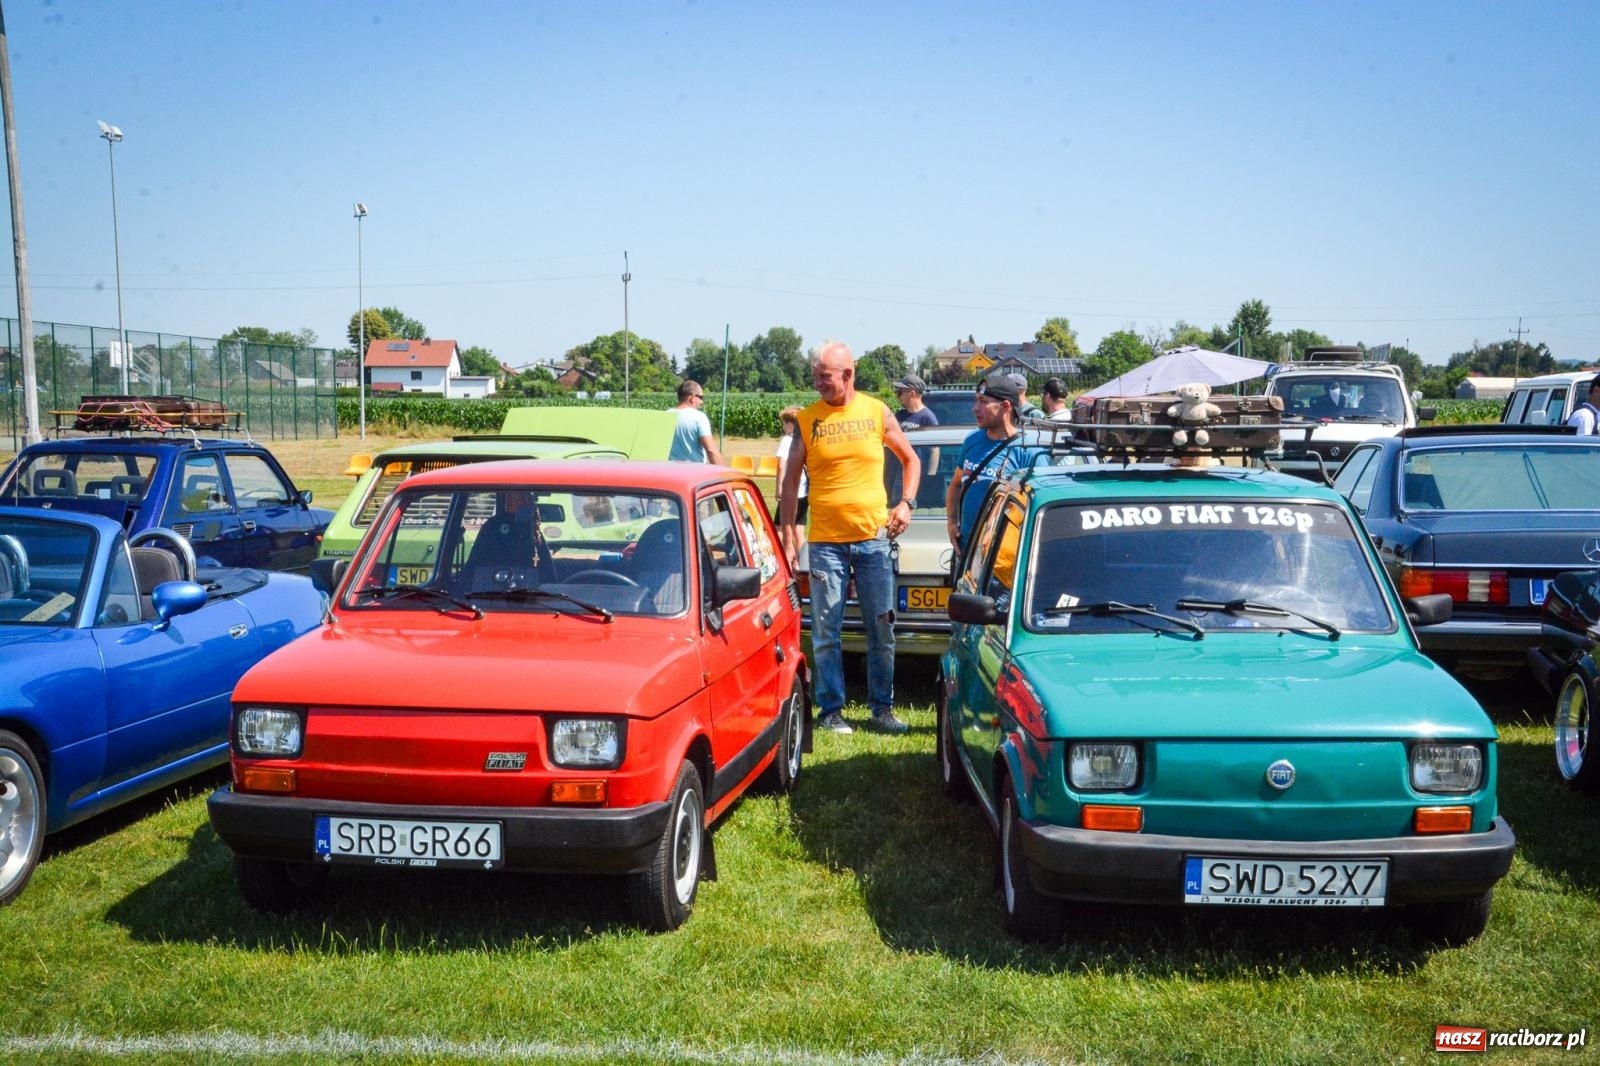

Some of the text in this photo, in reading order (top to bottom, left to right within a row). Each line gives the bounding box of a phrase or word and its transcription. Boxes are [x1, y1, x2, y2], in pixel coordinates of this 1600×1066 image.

[819, 419, 876, 438] BOXEUR
[1080, 506, 1162, 530] DARO
[1168, 506, 1235, 525] FIAT
[1242, 506, 1314, 534] 126p
[911, 589, 945, 607] SGL
[488, 760, 524, 768] FIAT
[1272, 770, 1292, 780] FIAT
[318, 822, 492, 858] PL SRB GR66
[375, 858, 438, 867] POLSKI FIAT
[1187, 862, 1382, 896] PL SWD 52X7
[1268, 897, 1318, 905] MALUCHY
